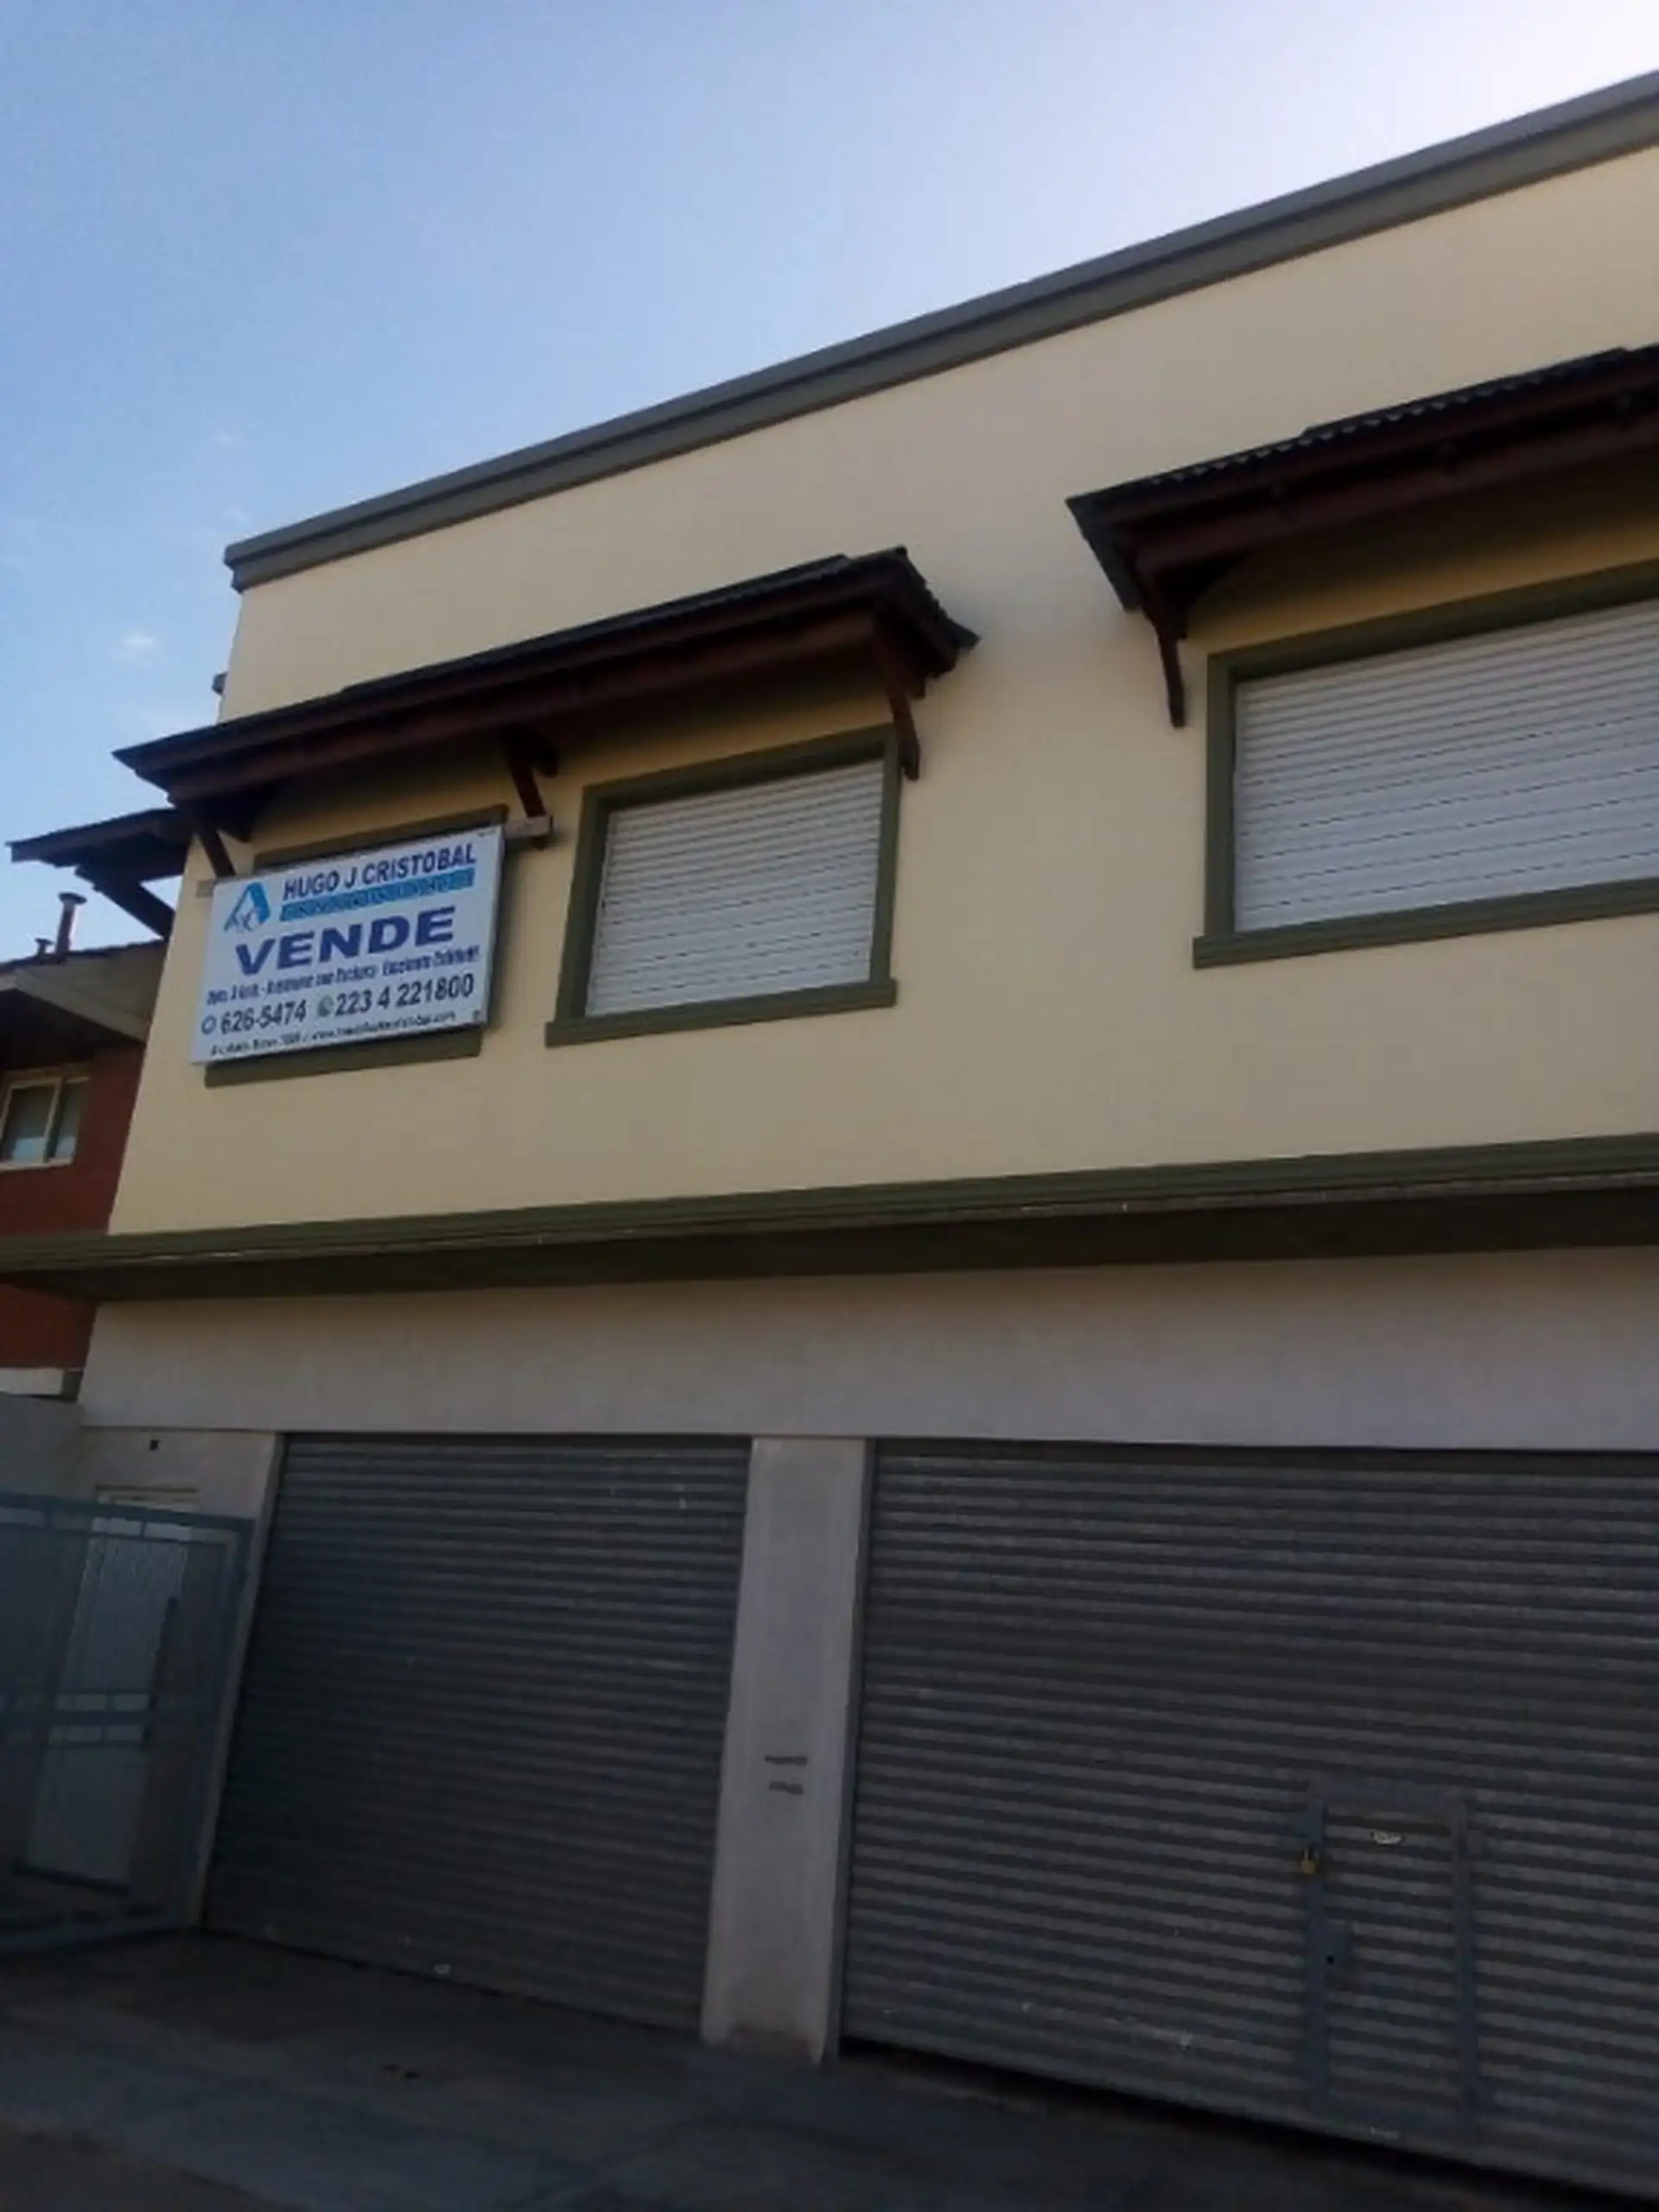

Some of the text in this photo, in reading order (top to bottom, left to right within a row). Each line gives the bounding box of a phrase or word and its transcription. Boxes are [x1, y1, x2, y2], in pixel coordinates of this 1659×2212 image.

[283, 869, 340, 900] HUGO
[345, 866, 357, 889] J
[362, 842, 476, 885] CRISTOBAL
[235, 906, 455, 976] VENDE
[334, 989, 372, 1016] 223
[377, 985, 391, 1009] 4
[397, 973, 474, 1007] 221800
